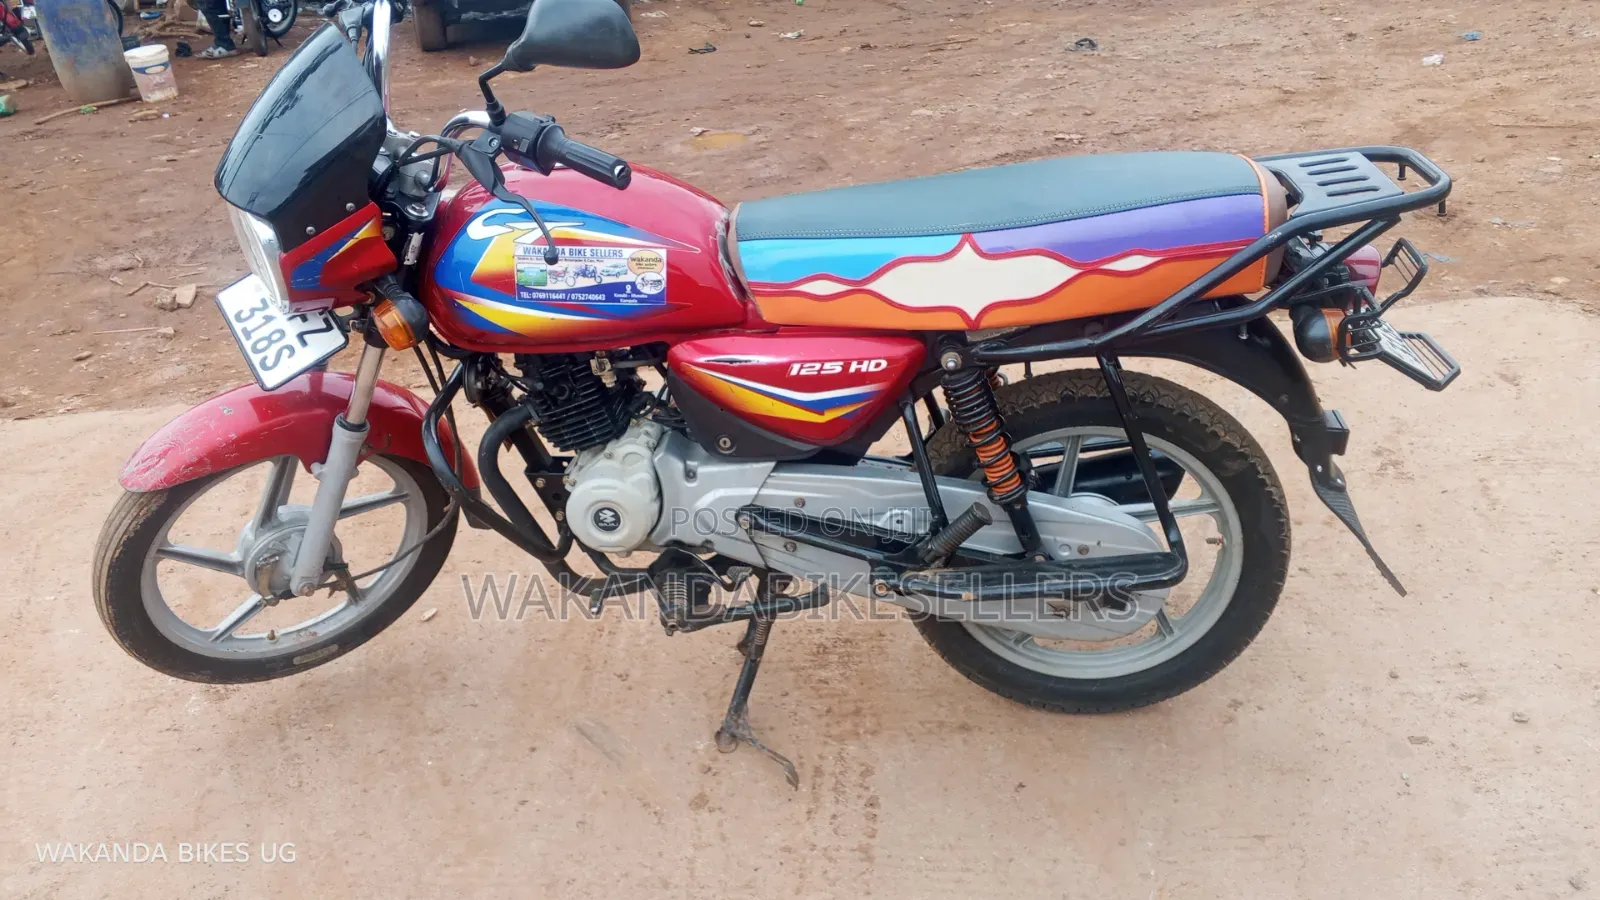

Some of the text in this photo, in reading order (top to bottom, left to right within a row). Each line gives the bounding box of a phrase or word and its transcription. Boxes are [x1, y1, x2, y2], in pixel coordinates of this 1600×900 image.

[523, 246, 623, 258] WAKADA BIKE SELLERS
[520, 291, 531, 299] TEL:
[233, 297, 296, 372] 318S
[789, 359, 888, 376] 125 HD
